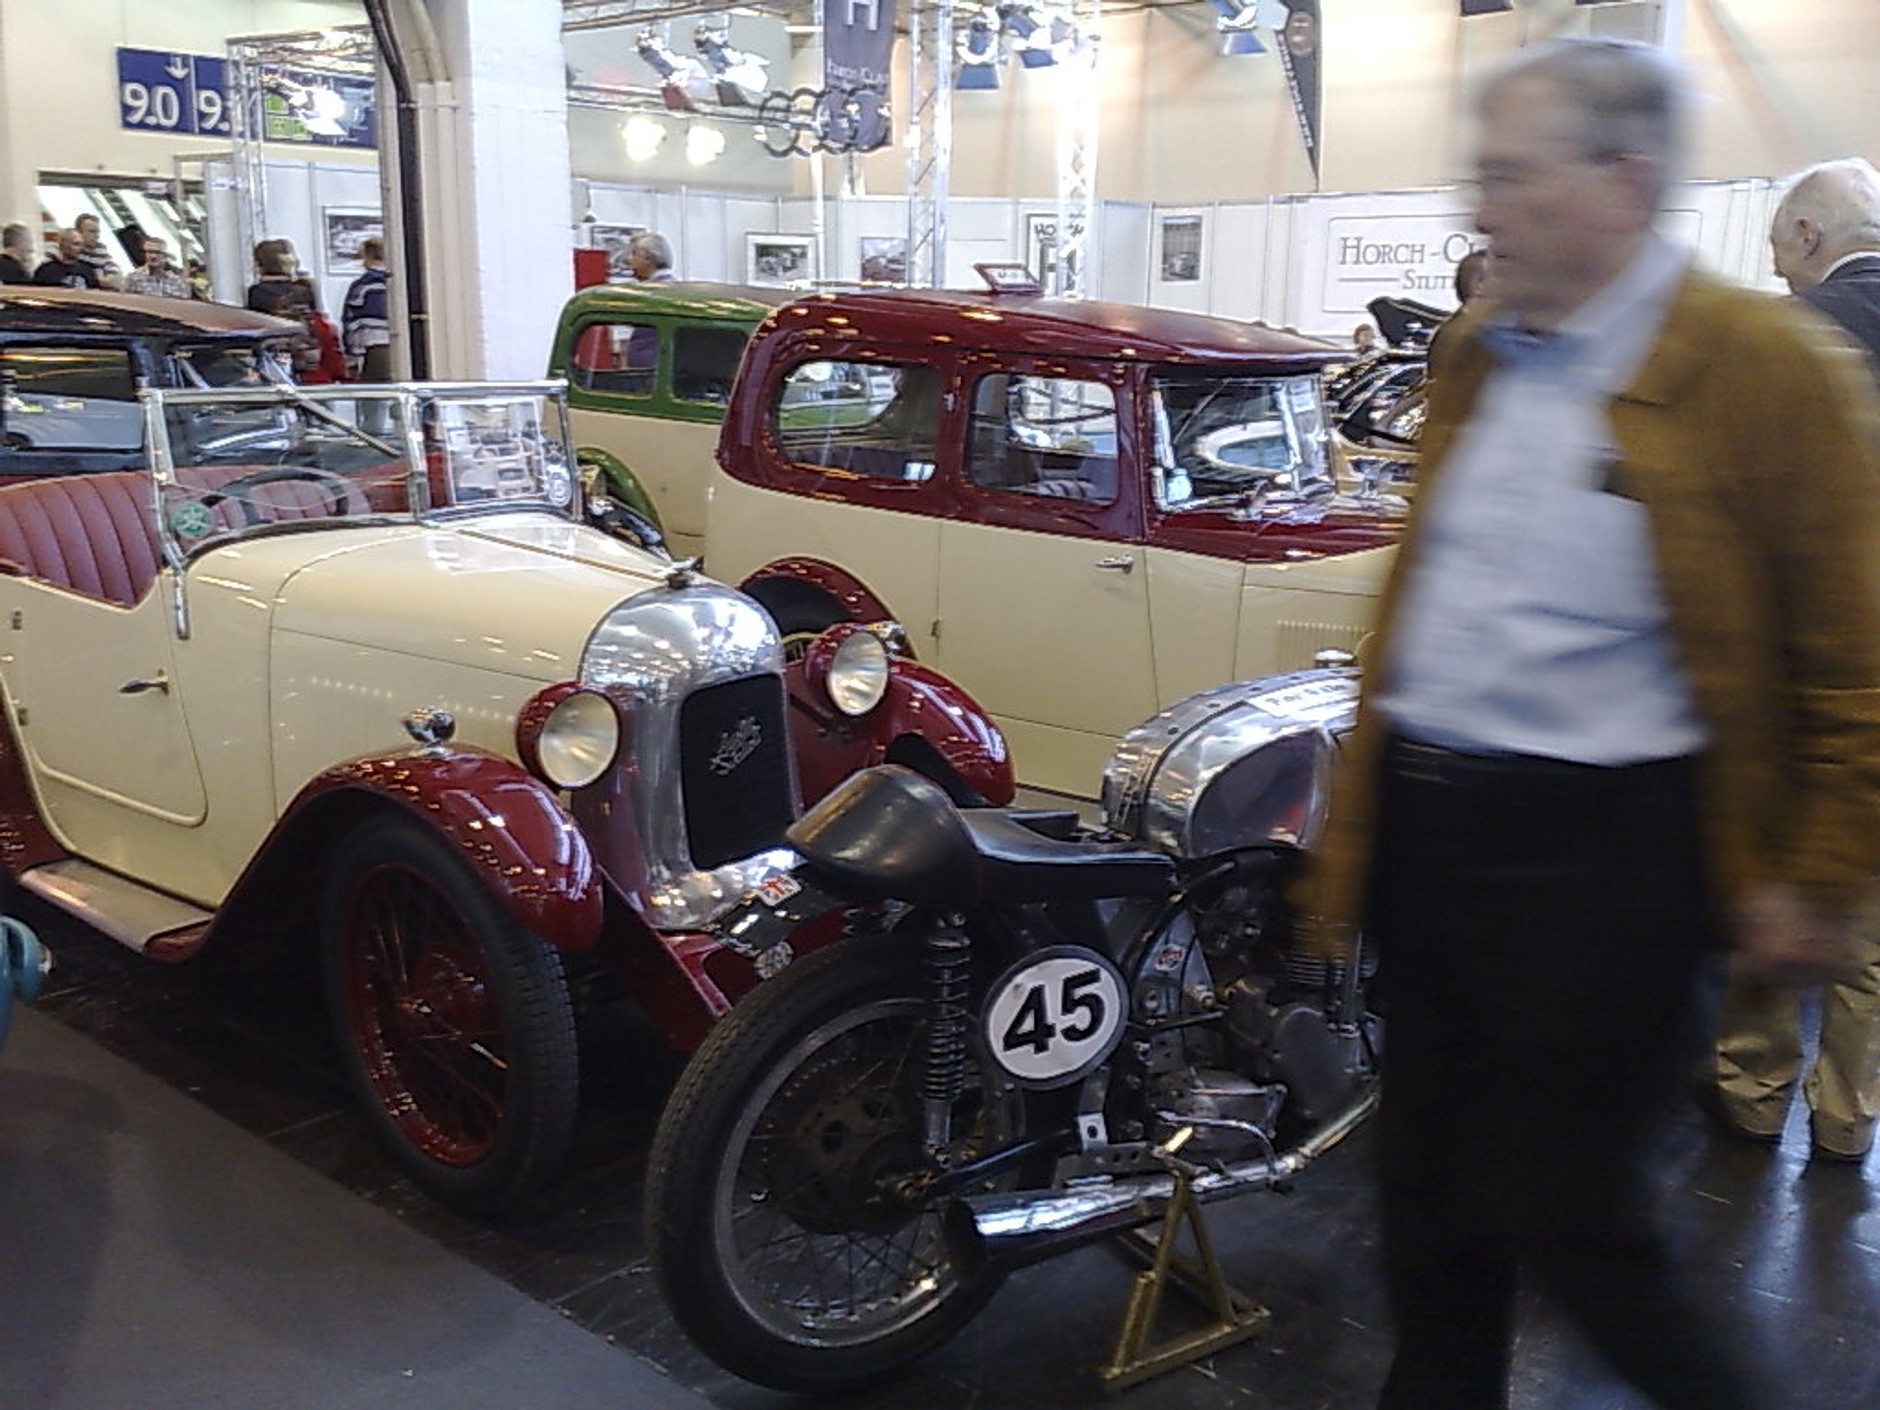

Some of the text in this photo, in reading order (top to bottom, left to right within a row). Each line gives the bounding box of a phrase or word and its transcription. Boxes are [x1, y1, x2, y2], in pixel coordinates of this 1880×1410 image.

[123, 82, 180, 128] 9.0
[197, 89, 234, 131] 9.
[1002, 967, 1106, 1055] 45
